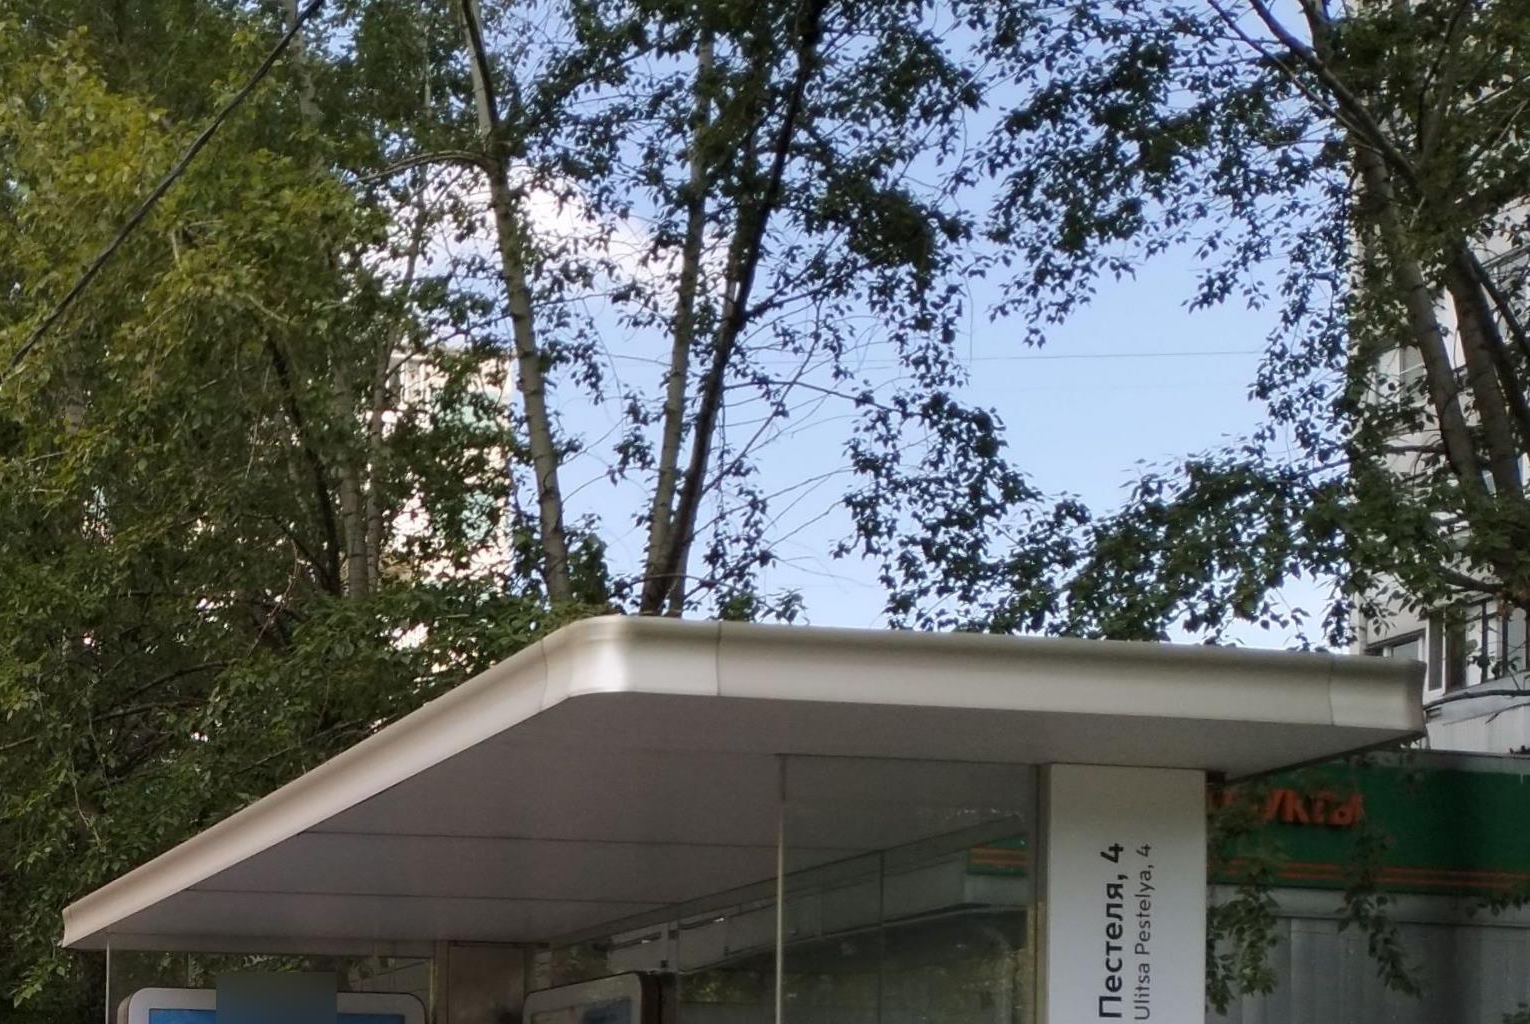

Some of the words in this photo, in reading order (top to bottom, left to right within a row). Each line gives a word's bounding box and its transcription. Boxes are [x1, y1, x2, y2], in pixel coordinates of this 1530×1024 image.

[1100, 843, 1124, 863] 4
[1135, 844, 1151, 857] 4
[1134, 865, 1155, 956] Pestelya,
[1098, 874, 1128, 1018] Пестеля,
[1134, 964, 1151, 1020] Ulitsa
